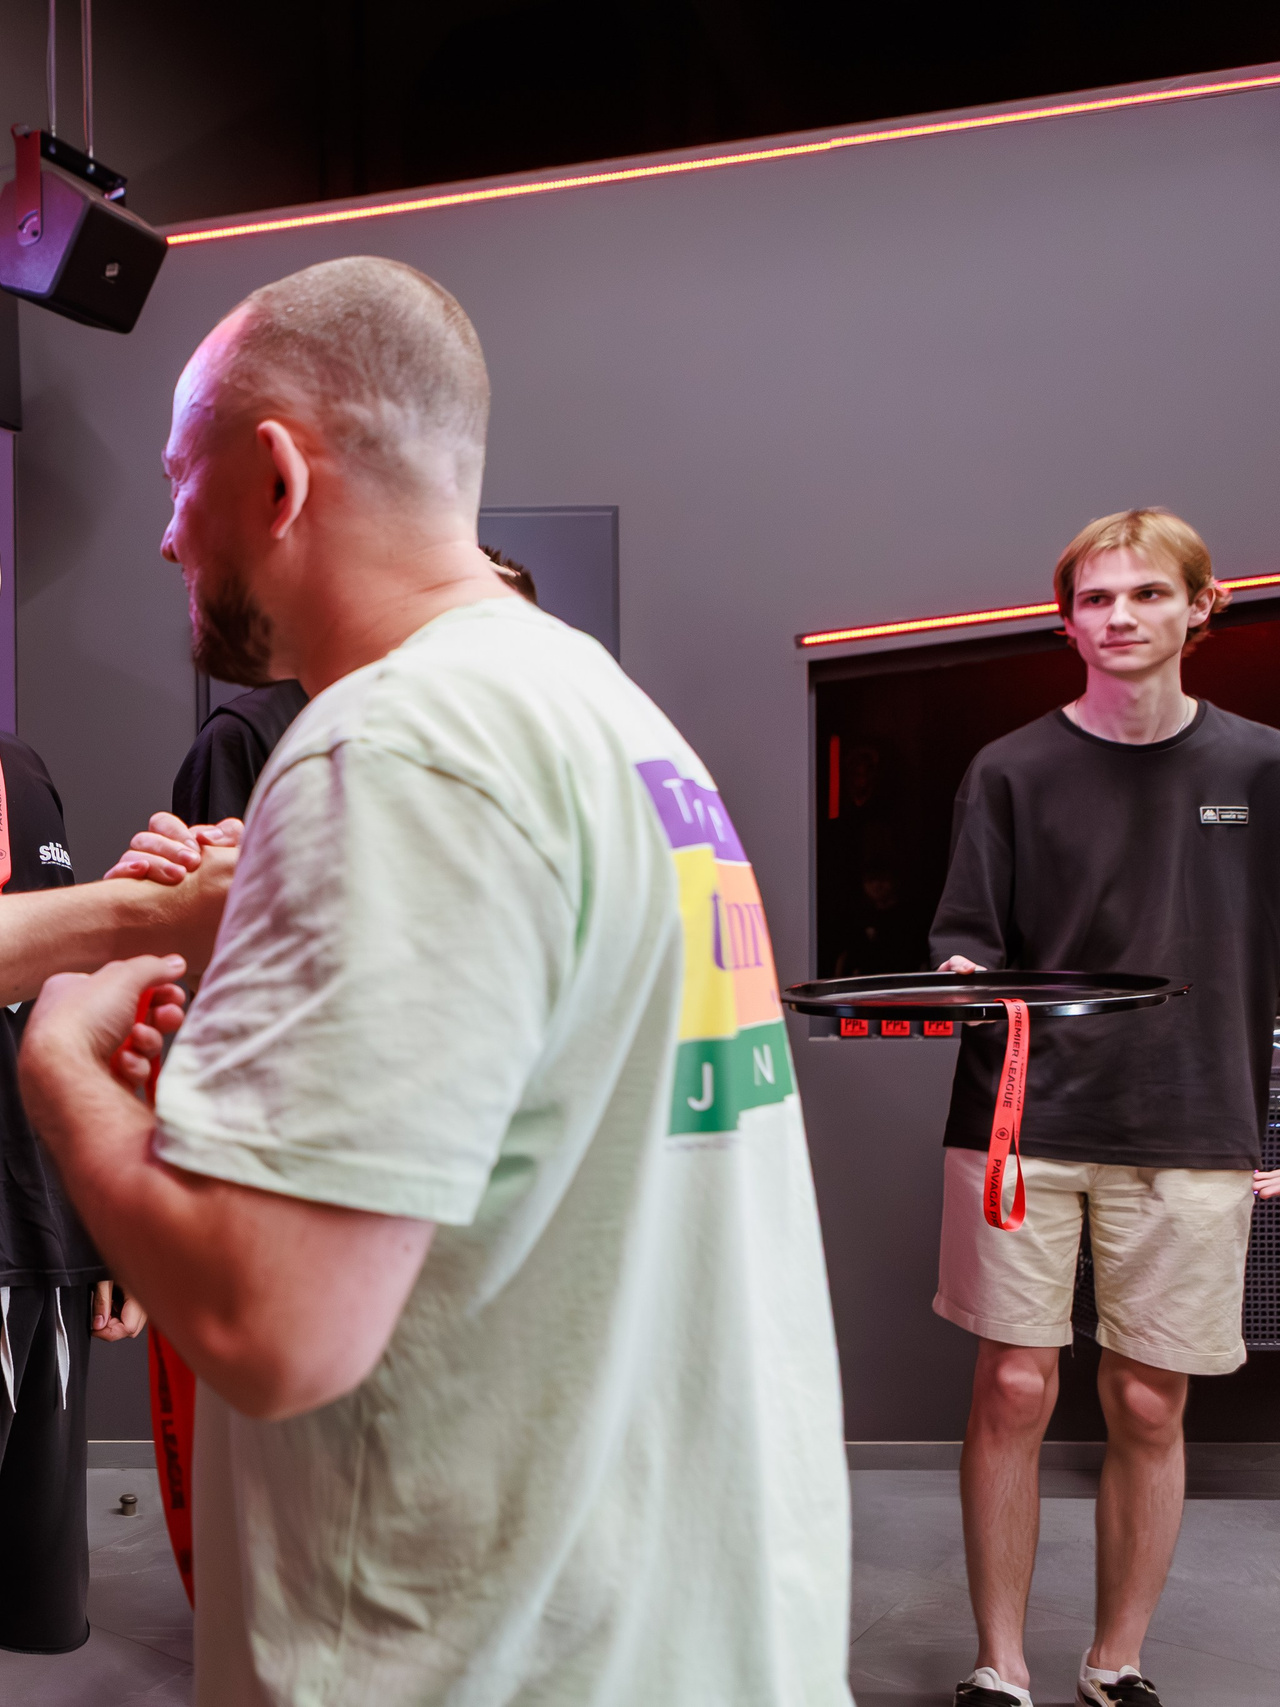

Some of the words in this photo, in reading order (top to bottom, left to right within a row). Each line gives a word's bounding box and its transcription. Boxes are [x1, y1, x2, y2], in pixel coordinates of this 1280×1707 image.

[844, 1019, 866, 1031] PPL
[1012, 1004, 1022, 1057] PREMIER
[1002, 1059, 1018, 1108] LEAGUE
[989, 1159, 1002, 1207] PAVAGA
